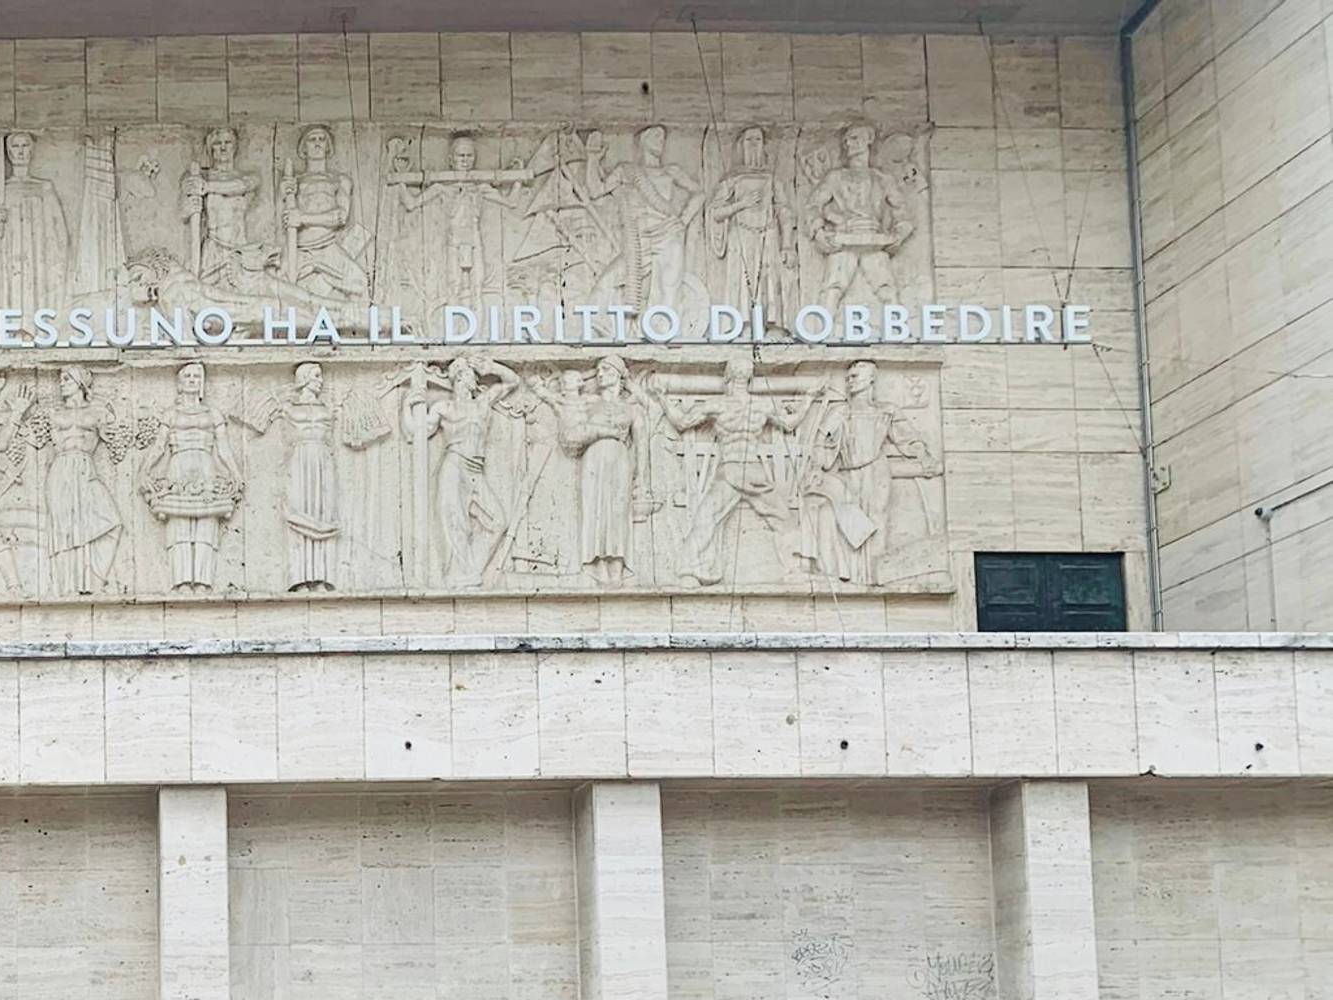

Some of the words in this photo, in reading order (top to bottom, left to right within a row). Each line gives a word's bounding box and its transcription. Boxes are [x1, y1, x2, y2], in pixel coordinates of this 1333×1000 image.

[264, 306, 341, 345] HA
[369, 306, 415, 343] IL
[444, 304, 679, 343] DIRITTO
[709, 304, 763, 343] DI
[794, 304, 1093, 343] OBBEDIRE
